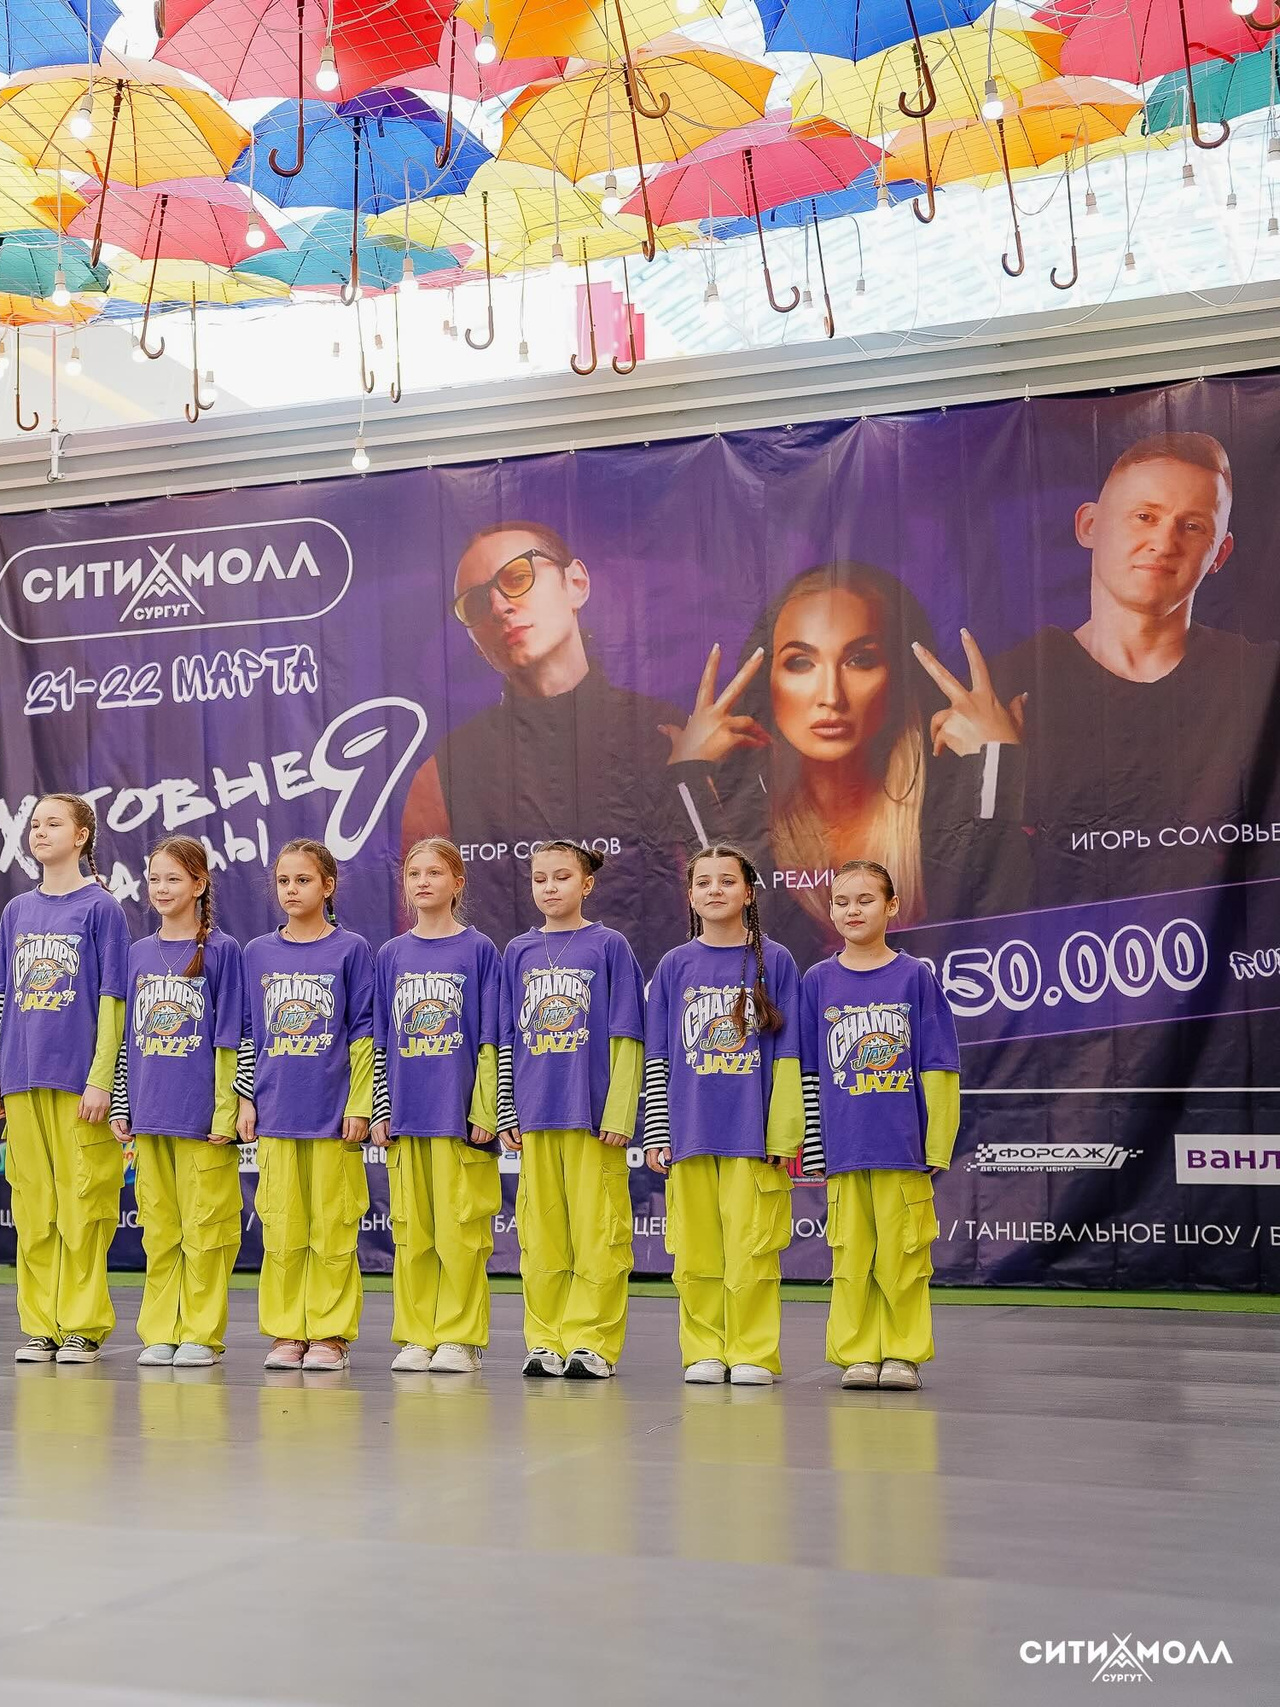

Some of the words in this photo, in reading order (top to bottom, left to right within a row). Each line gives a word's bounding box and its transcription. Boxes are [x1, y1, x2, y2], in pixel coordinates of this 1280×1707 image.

[21, 556, 142, 603] СИТИ
[180, 541, 322, 587] МОЛЛ
[132, 603, 191, 621] СУРГУТ
[23, 662, 163, 716] 21-22
[171, 644, 319, 704] МАРТА
[1072, 829, 1151, 851] ИГОРЬ
[459, 842, 508, 862] ЕГОР
[13, 939, 80, 991] CHAMPS
[918, 918, 1209, 1018] 50.000
[21, 992, 64, 1013] JAZZ
[61, 989, 77, 1002] 98
[264, 979, 335, 1030] CHAMPS
[518, 973, 591, 1033] CHAMPS
[133, 980, 205, 1035] CHAMPS
[142, 1036, 189, 1058] JAZZ
[187, 1034, 203, 1047] 98
[267, 1036, 320, 1058] JAZZ
[318, 1033, 334, 1046] 98
[399, 1036, 454, 1058] JAZZ
[530, 1033, 579, 1056] JAZZ
[827, 1010, 912, 1073] CHAMPS
[695, 1053, 754, 1075] JAZZ
[849, 1073, 910, 1096] JAZZ
[998, 1147, 1106, 1159] ФОРСАЖ
[964, 1220, 1167, 1244] ТАНЦЕВАЛЬНОЕ
[1173, 1224, 1241, 1246] ШОУ
